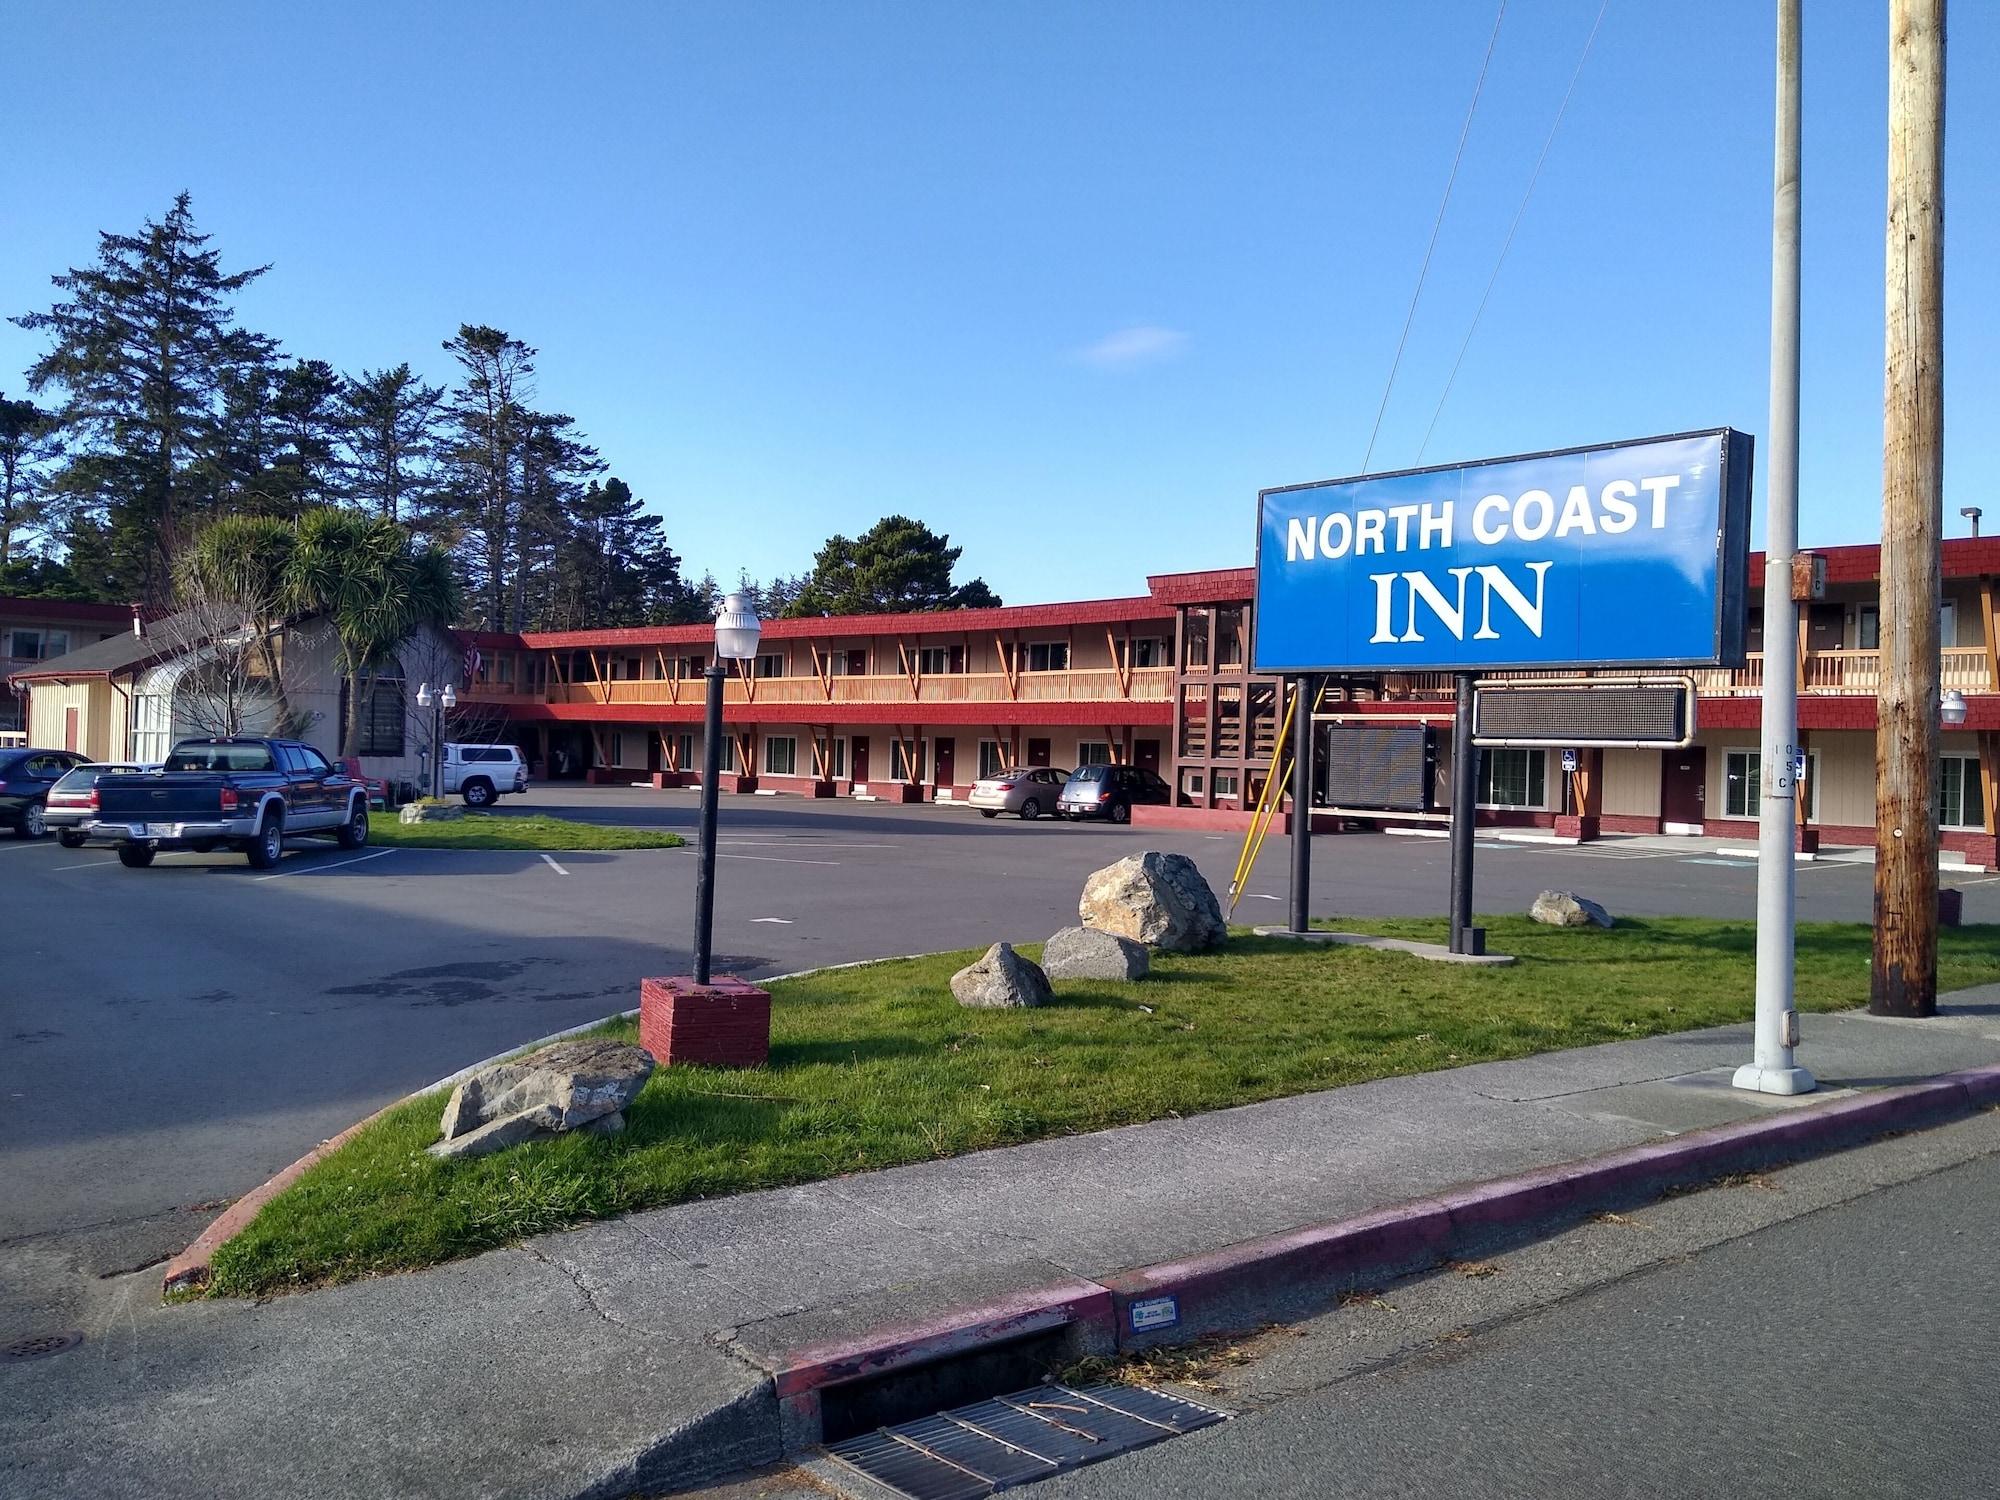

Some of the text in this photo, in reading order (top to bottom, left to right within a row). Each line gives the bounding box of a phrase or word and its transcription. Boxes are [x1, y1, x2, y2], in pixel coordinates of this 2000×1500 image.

[1287, 474, 1681, 562] NORTH COAST
[1369, 560, 1554, 643] INN
